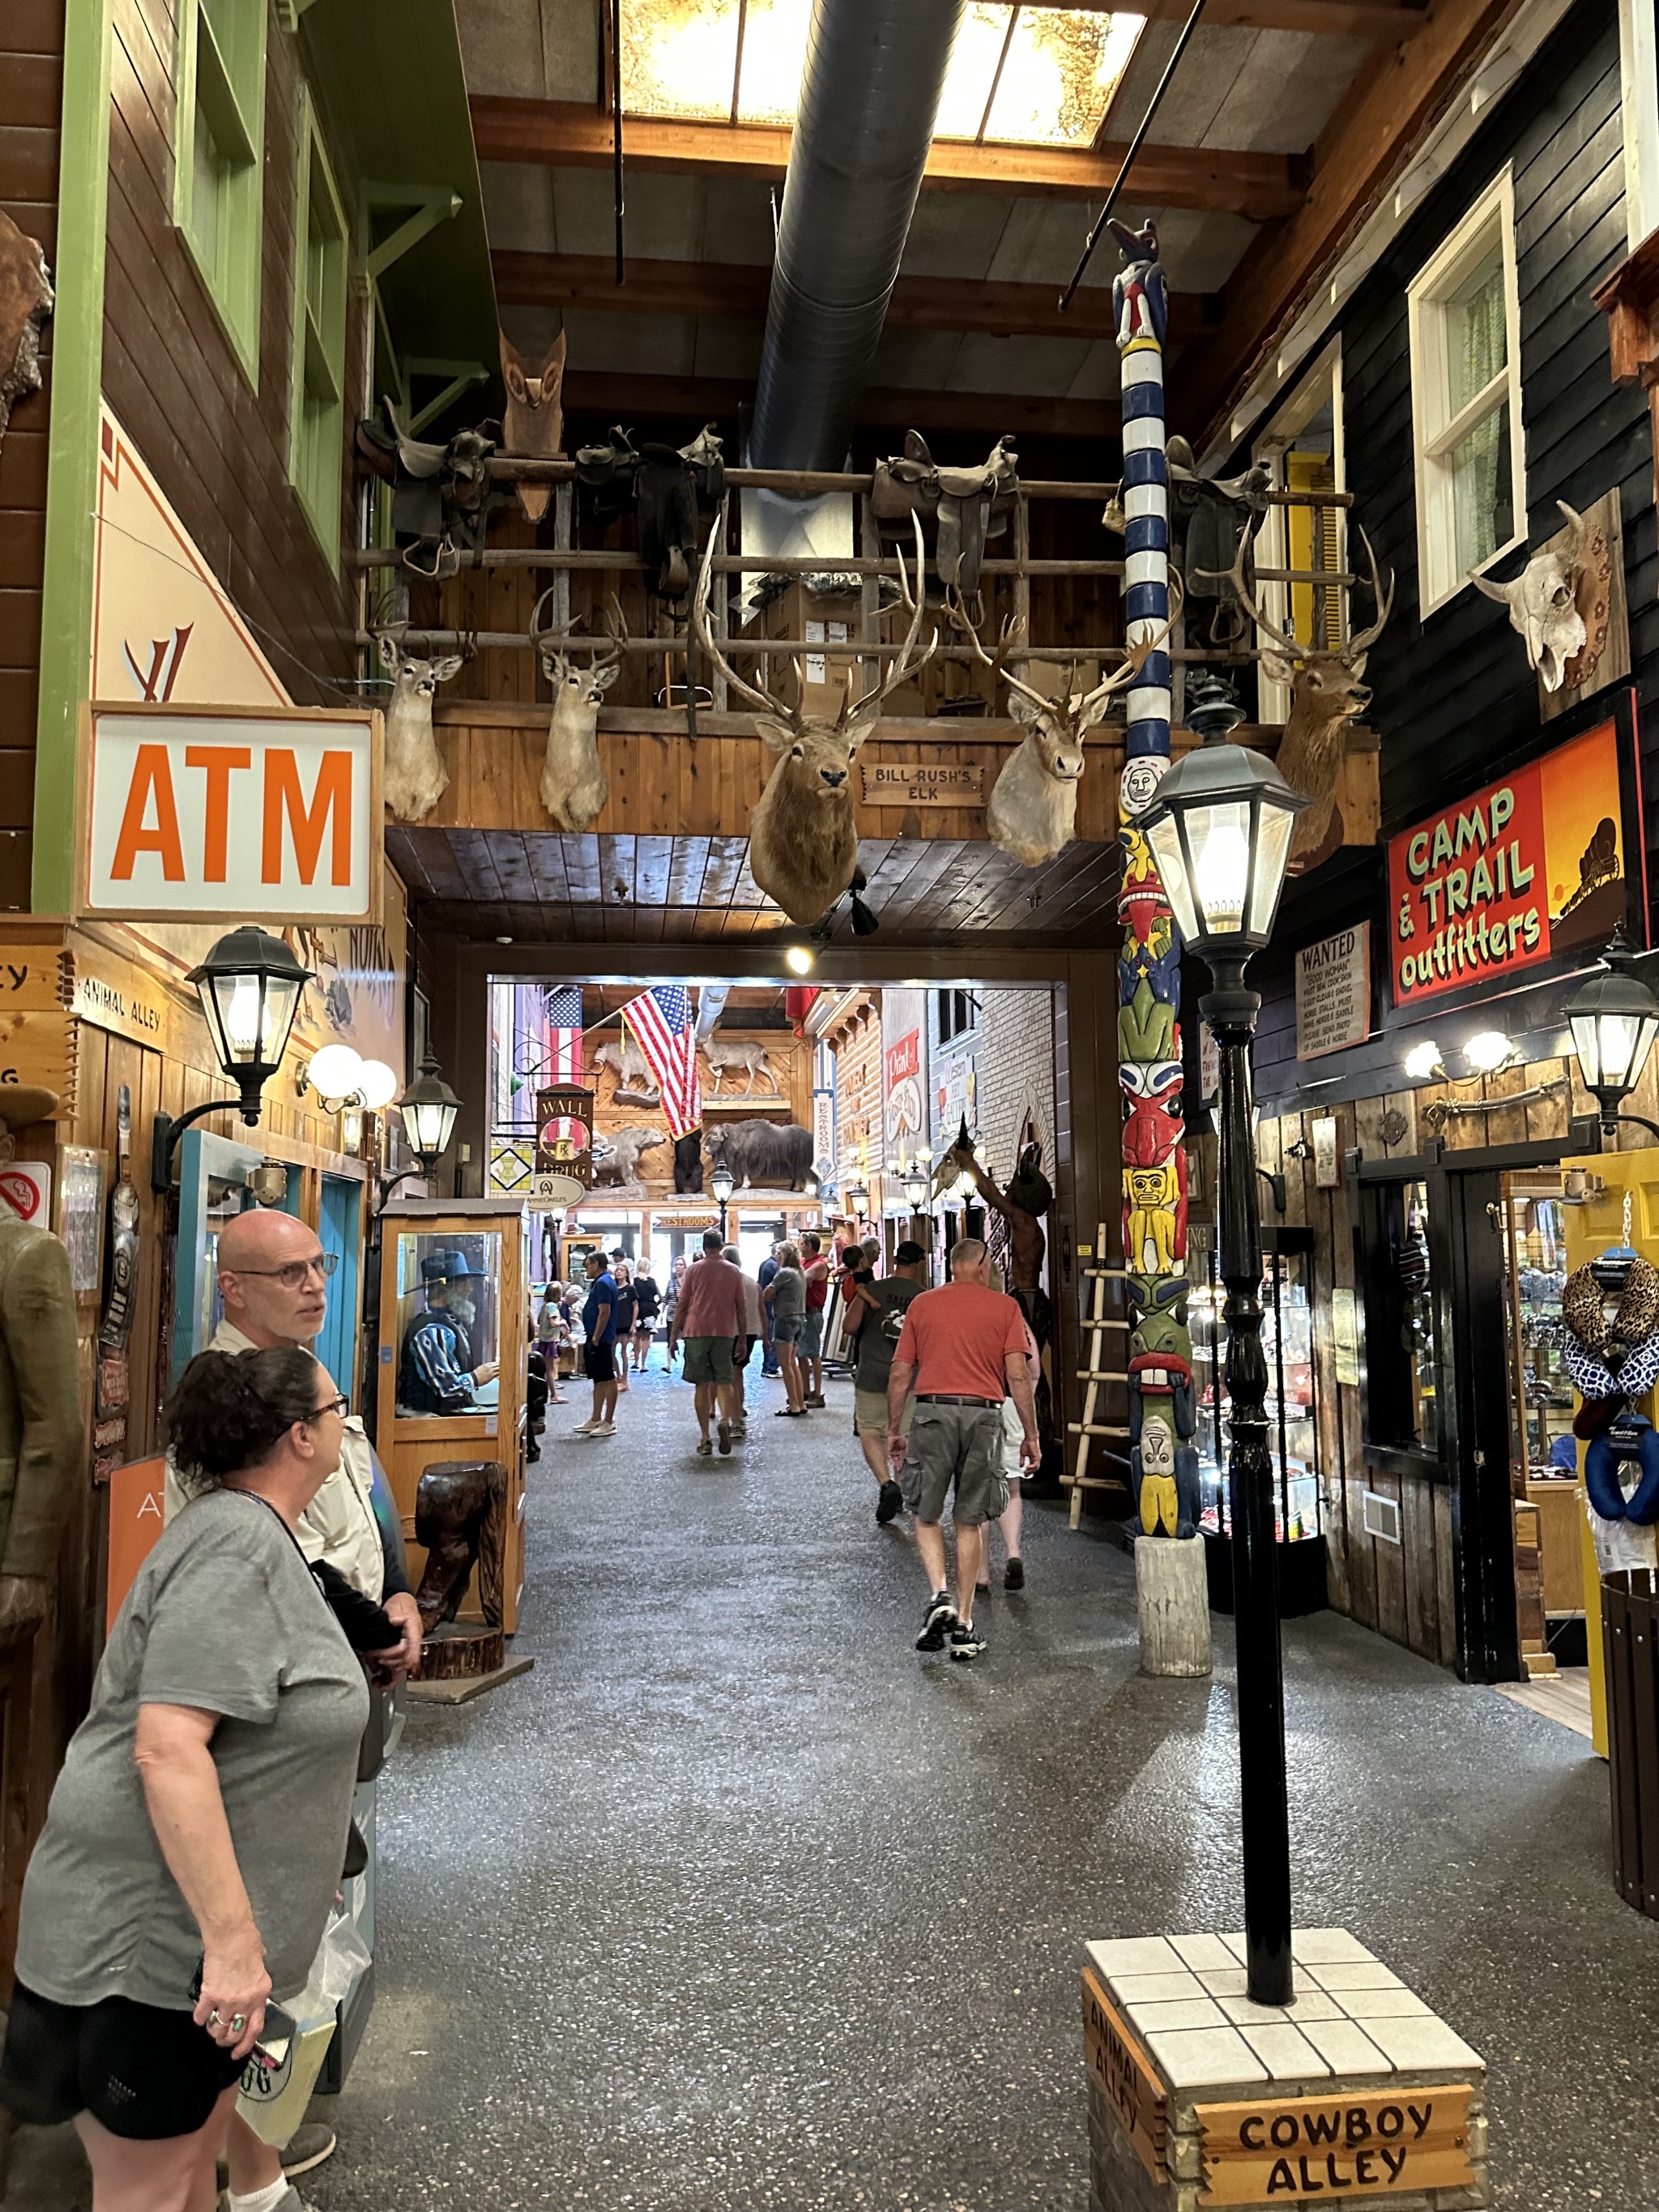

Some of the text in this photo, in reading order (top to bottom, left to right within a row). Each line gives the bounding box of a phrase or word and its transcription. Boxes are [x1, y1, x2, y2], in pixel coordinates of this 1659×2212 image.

[876, 768, 971, 784] BILL RUSH'S
[908, 786, 938, 801] ELK
[110, 743, 353, 886] ATM
[1408, 788, 1515, 878] CAMP
[1399, 839, 1535, 938] & TRAIL
[1302, 931, 1355, 973] WANTED
[1401, 907, 1541, 988] outfitters
[83, 977, 161, 1033] ANIMAL ALLEY
[1303, 1007, 1317, 1019] HORSE
[1338, 994, 1352, 1007] MUST
[1303, 1018, 1315, 1030] HAVE
[1316, 1013, 1330, 1026] HORSE
[1336, 1005, 1354, 1020] SADDLE
[1316, 991, 1330, 1003] CLEAN
[1303, 1028, 1320, 1042] PLEASE
[1322, 1023, 1335, 1036] SEND
[1311, 1037, 1326, 1051] SADDLE
[1333, 1031, 1348, 1044] HORSE
[542, 1099, 587, 1117] WALL
[818, 1102, 830, 1155] RESTROOMS
[543, 1162, 586, 1177] DRUG
[660, 1216, 714, 1227] RESTROOMS
[1090, 1998, 1143, 2107] ANIMAL
[1095, 2044, 1137, 2133] ALLEY
[1239, 2103, 1434, 2151] COWBOY
[1265, 2146, 1408, 2196] ALLEY
